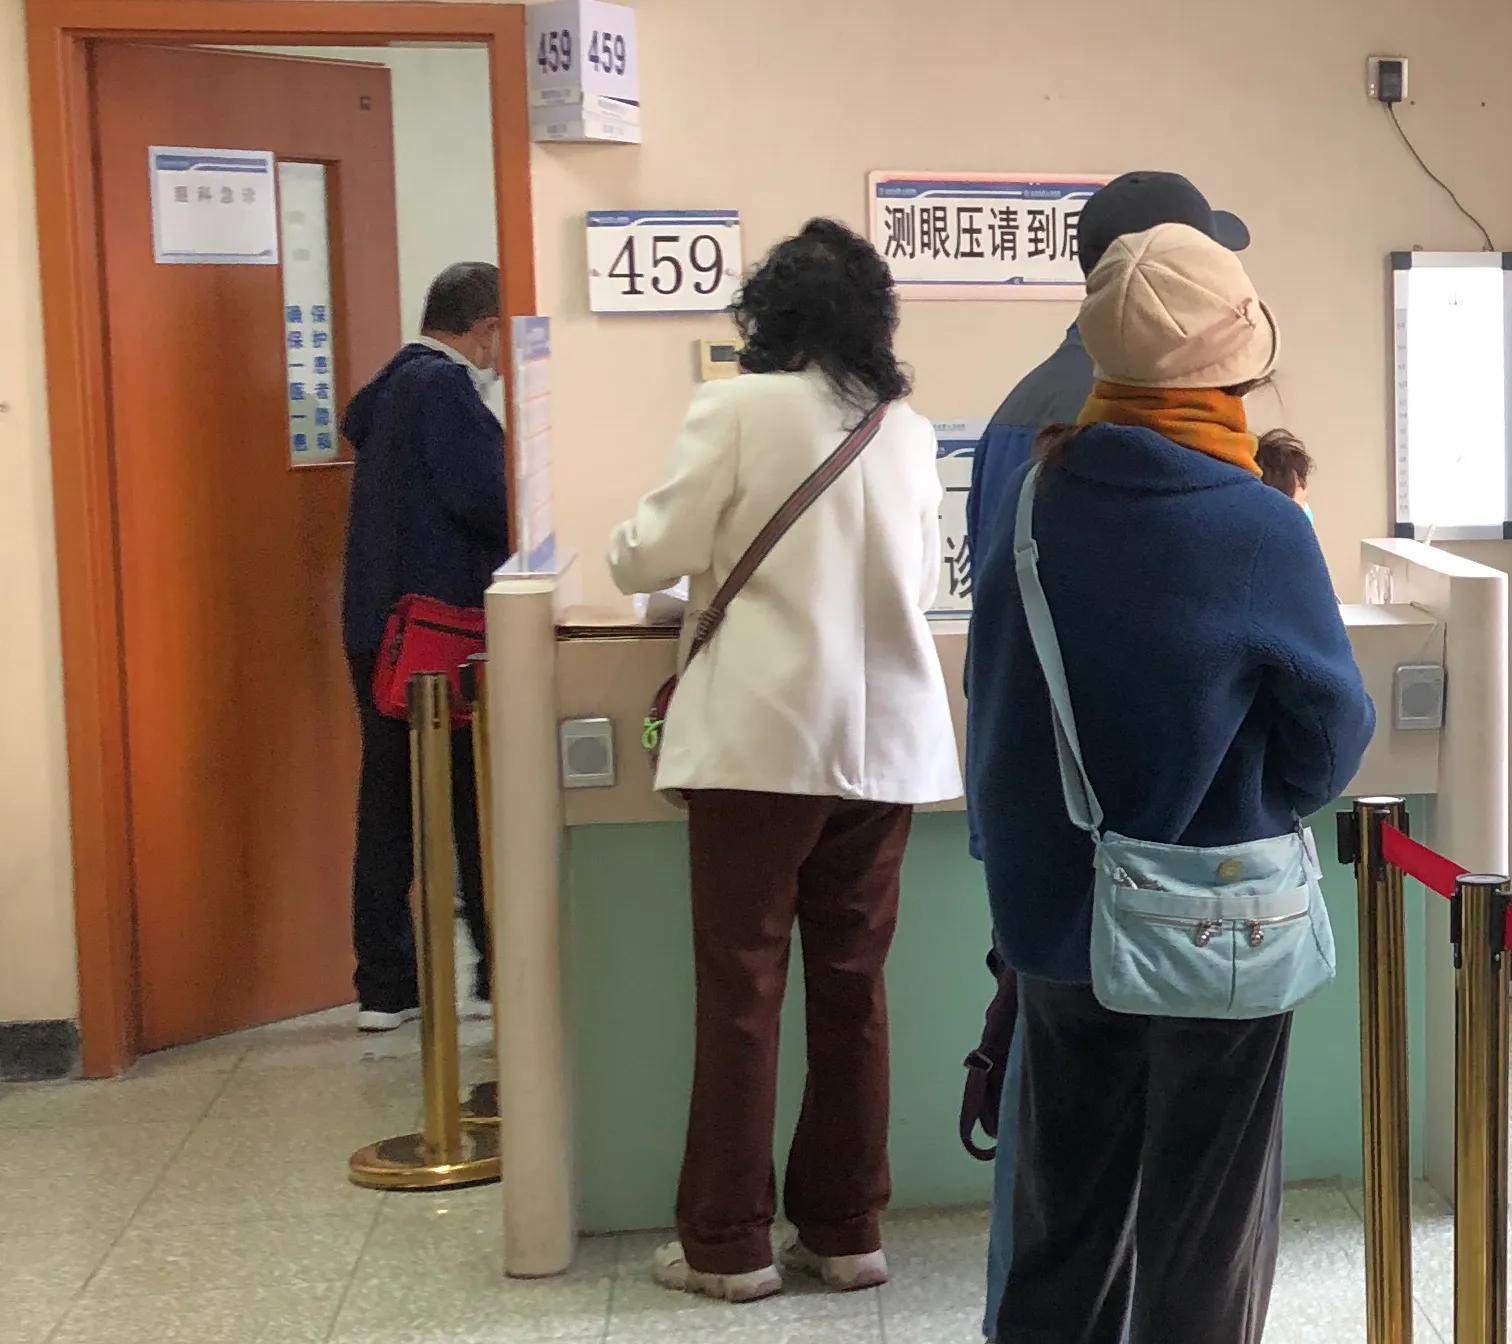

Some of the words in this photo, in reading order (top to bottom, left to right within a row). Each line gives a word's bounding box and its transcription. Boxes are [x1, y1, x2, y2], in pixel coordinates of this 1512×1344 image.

[537, 29, 572, 74] 459
[588, 30, 626, 76] 459
[608, 234, 724, 295] 459
